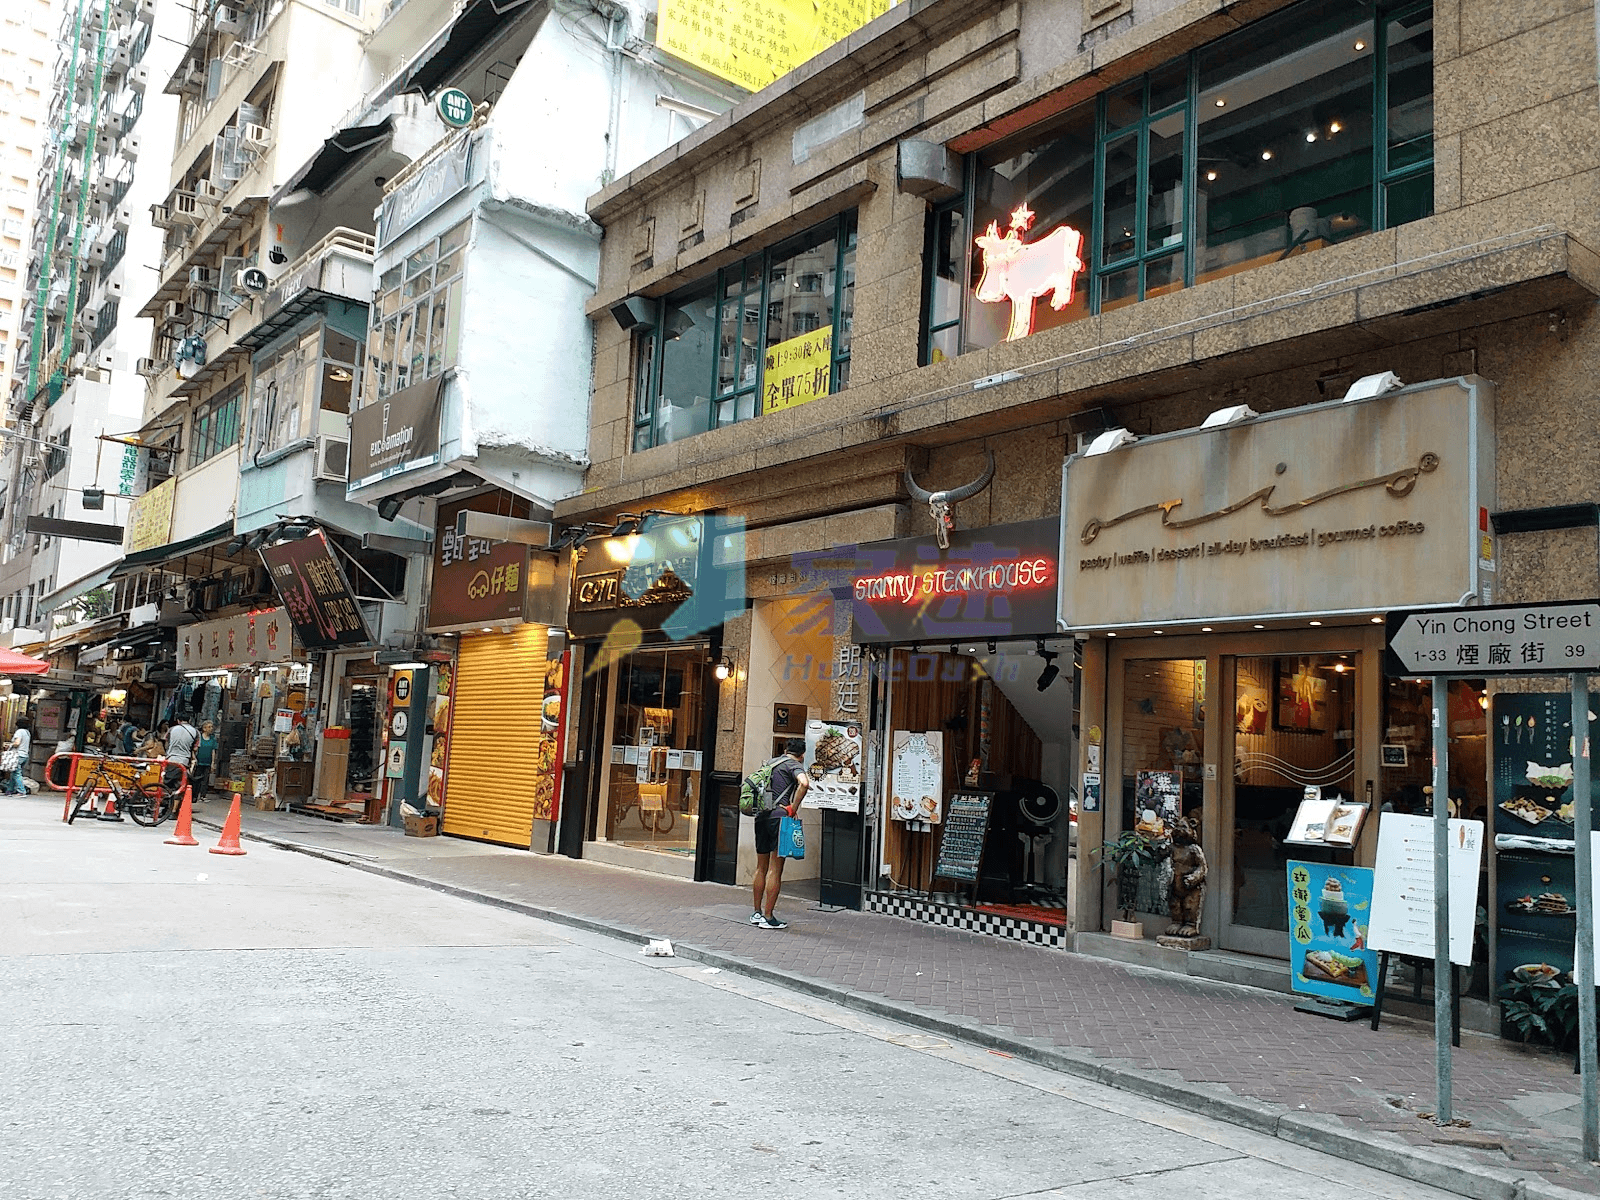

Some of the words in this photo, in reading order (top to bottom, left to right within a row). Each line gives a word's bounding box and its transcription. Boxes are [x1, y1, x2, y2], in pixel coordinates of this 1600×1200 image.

[447, 93, 468, 109] ANT
[446, 105, 467, 121] TOY
[765, 364, 829, 410] 全單75折
[1080, 555, 1111, 572] pastry
[1118, 549, 1149, 565] waffle
[1157, 545, 1200, 562] dessert
[1207, 540, 1248, 557] all-day
[1250, 532, 1309, 551] breakfast
[1318, 525, 1376, 547] gourmet
[1378, 520, 1425, 537] coffee
[855, 573, 919, 604] STARRY
[922, 558, 1048, 594] STEAKHOUSE
[1417, 619, 1446, 635] Yin
[1453, 616, 1515, 634] Chong
[1523, 611, 1592, 630] Street
[1414, 650, 1447, 662] 1-33
[1456, 642, 1545, 665] 煙廠街
[1565, 645, 1585, 658] 39
[837, 645, 861, 722] 朗廷
